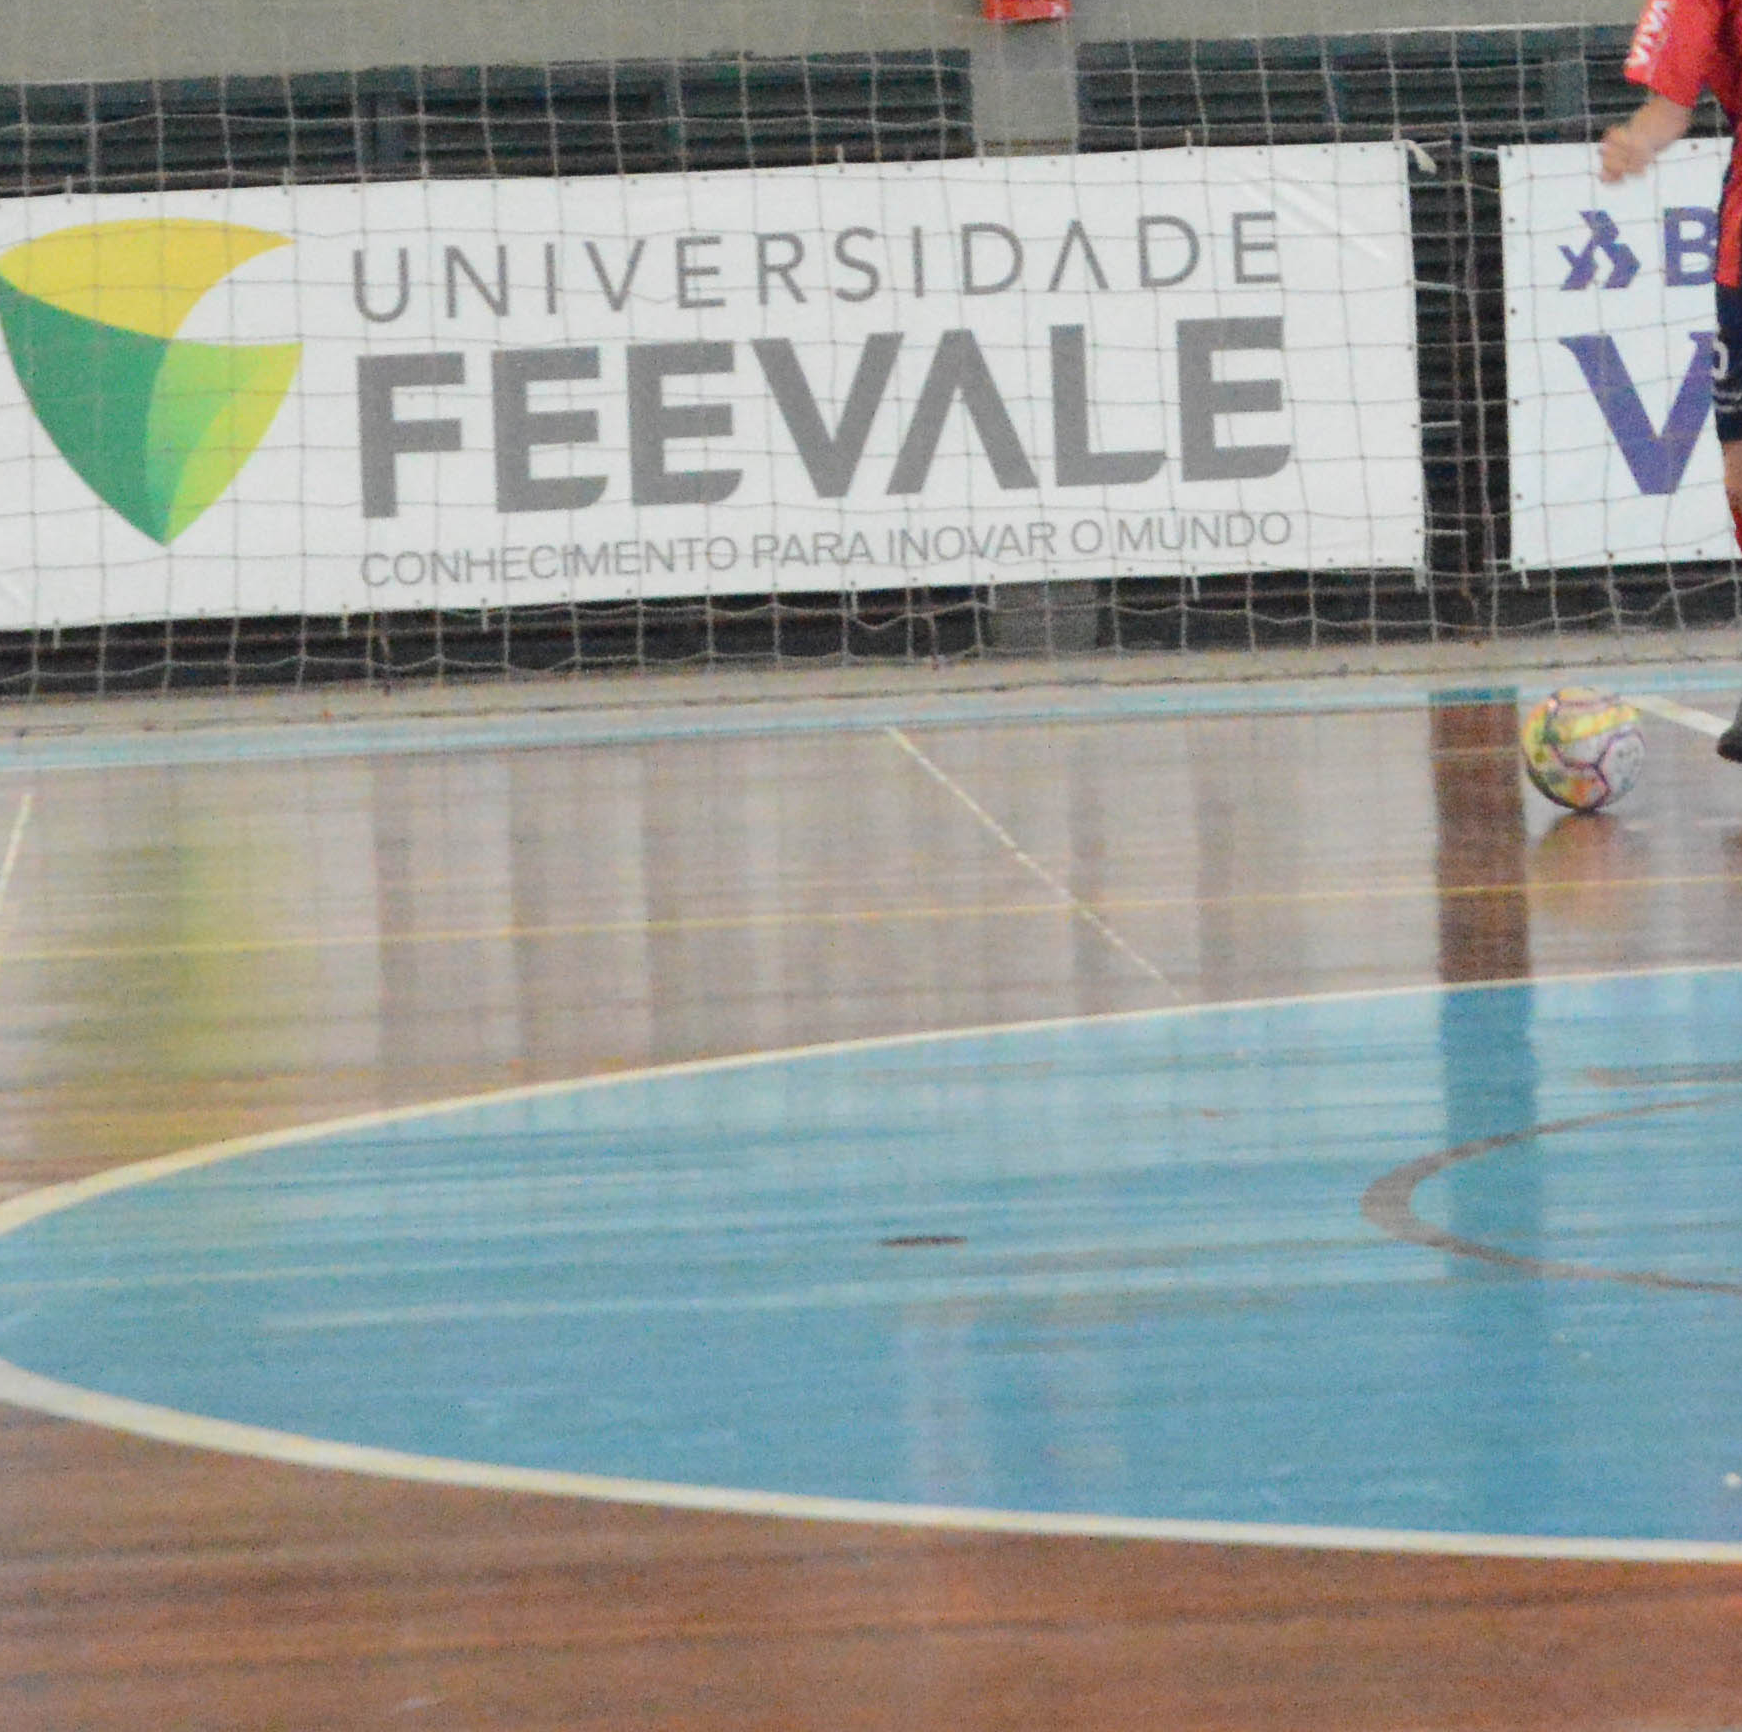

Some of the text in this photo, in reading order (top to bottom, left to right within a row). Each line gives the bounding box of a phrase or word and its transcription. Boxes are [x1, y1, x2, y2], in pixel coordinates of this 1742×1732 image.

[352, 211, 1281, 324] UNIVERSIDADE
[356, 315, 1292, 519] FEEVALE
[361, 510, 1292, 588] CONHECIMENTO PARA INOVAR O MUNDO
